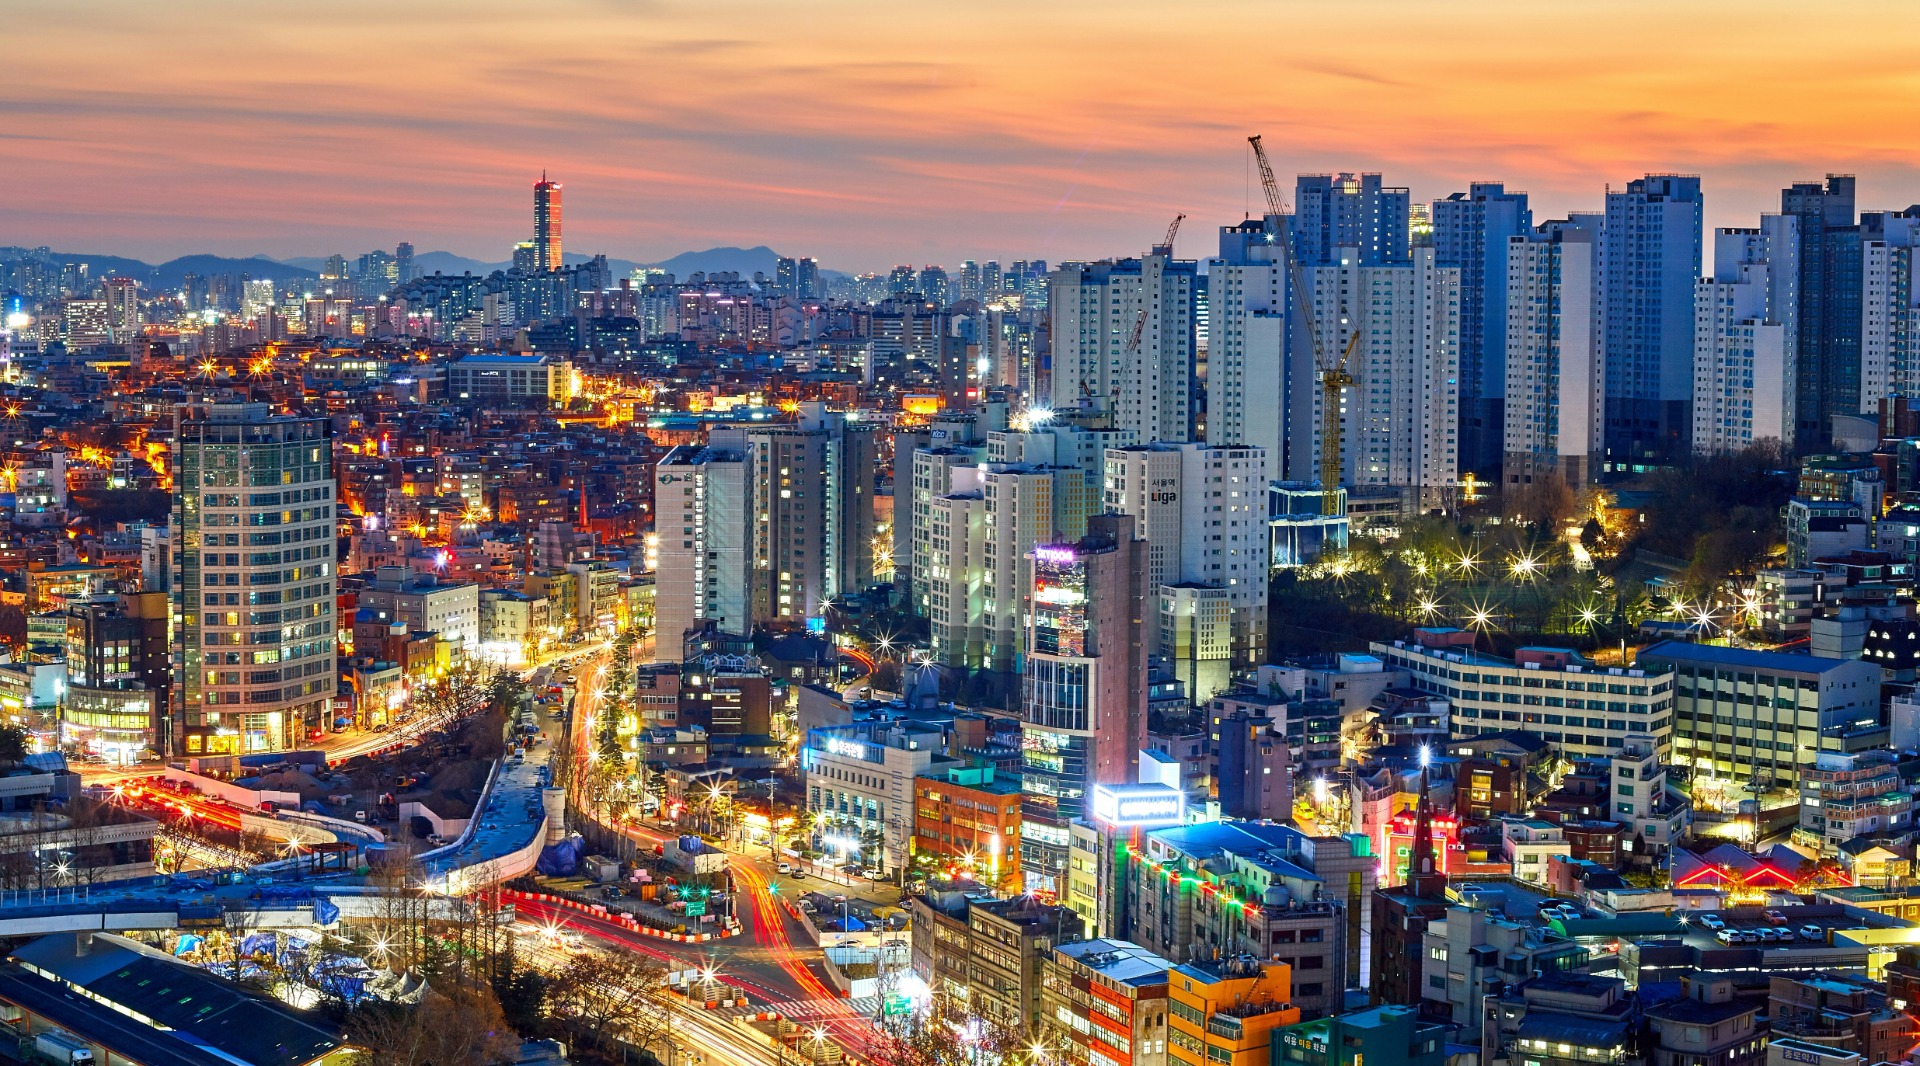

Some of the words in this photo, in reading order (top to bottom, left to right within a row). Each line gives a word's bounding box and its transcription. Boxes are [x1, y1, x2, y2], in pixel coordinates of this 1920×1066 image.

[932, 430, 945, 438] KCC
[1152, 478, 1175, 487] 서울역
[1151, 489, 1176, 504] Liga
[838, 740, 863, 759] 우리은
[1284, 1035, 1297, 1046] 이용
